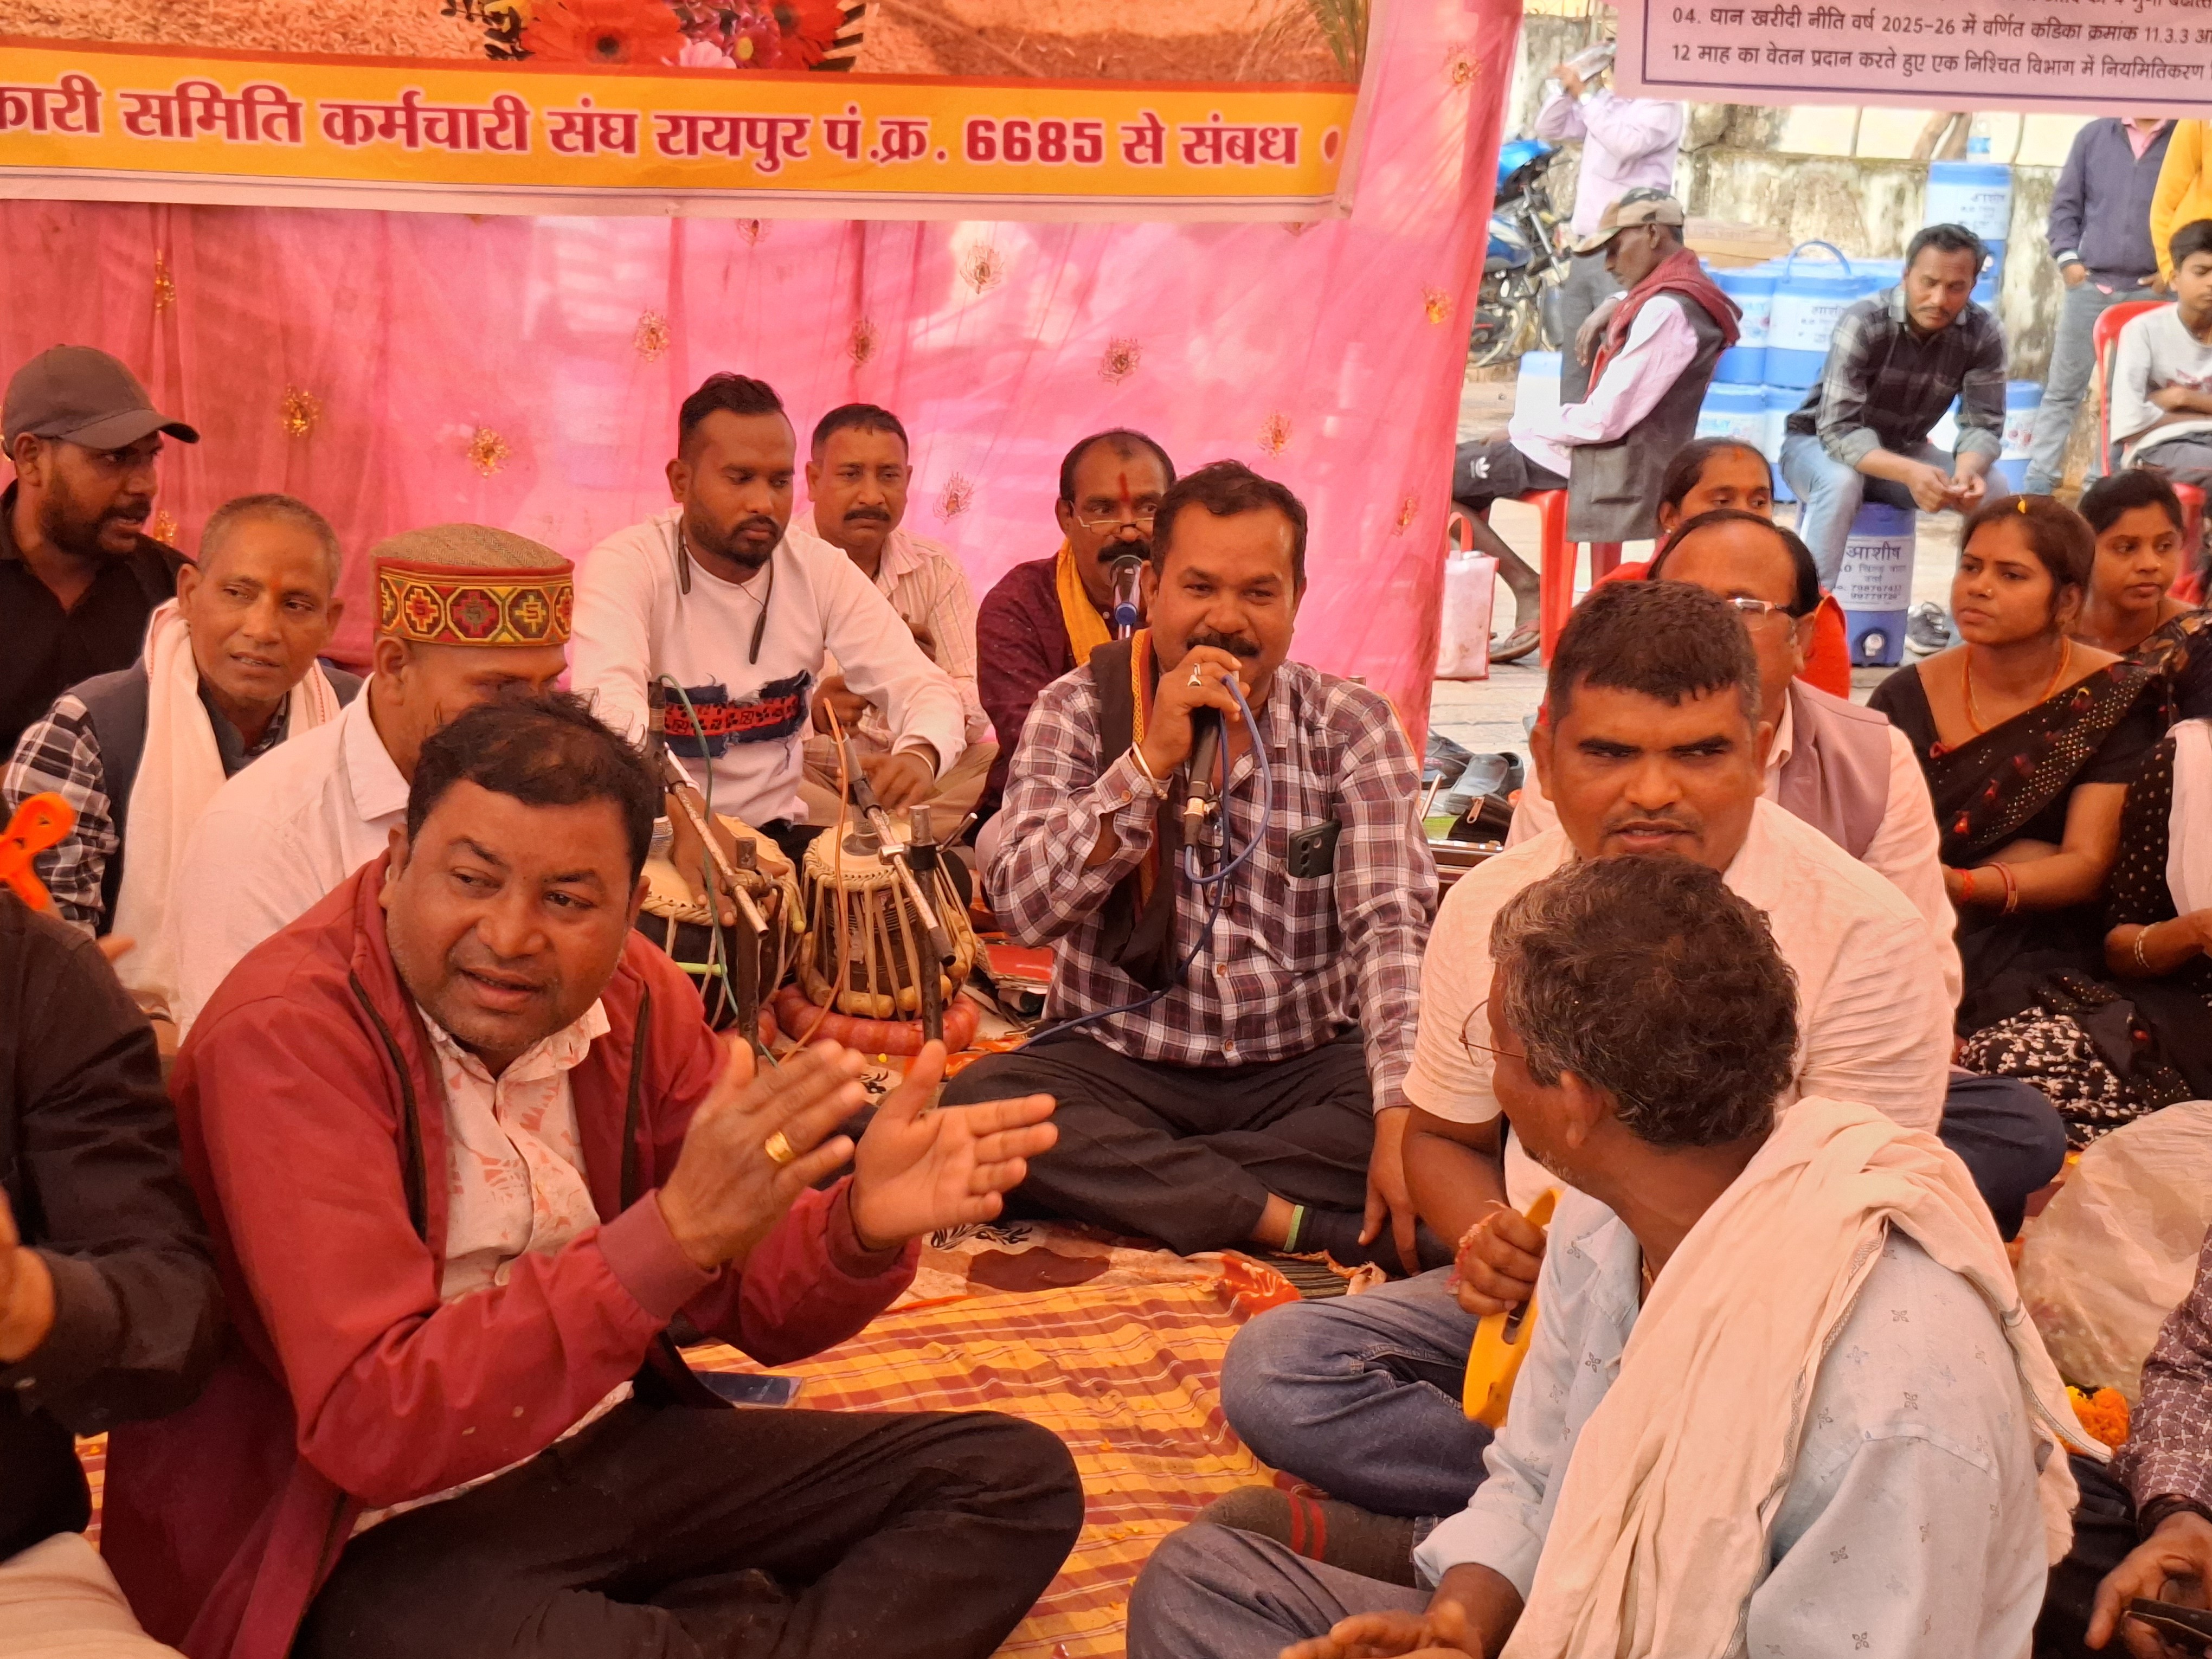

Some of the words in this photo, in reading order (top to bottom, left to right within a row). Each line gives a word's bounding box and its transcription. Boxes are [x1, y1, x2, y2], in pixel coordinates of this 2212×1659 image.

[1673, 7, 1701, 24] 04.
[1710, 9, 1745, 25] धान
[1751, 4, 1802, 28] खरीदी
[1808, 6, 1846, 29] नीति
[1851, 8, 1876, 30] वर्ष
[1882, 16, 1955, 34] 2025-26
[1962, 13, 1977, 35] में
[1983, 14, 2025, 36] वर्णित
[2088, 21, 2139, 41] क्रमांक
[2145, 27, 2189, 44] 11.3.3
[1673, 45, 1690, 61] 12
[1697, 46, 1732, 64] माह
[1738, 48, 1760, 63] का
[1766, 41, 1805, 65] वेतन
[1811, 50, 1853, 67] प्रदान
[1859, 47, 1897, 68] करते
[1903, 54, 1925, 76] हुए
[1932, 55, 1959, 72] एक
[2028, 52, 2075, 75] विभाग
[2081, 54, 2095, 76] में
[2101, 55, 2204, 80] नियमितिकरण
[119, 82, 303, 144] समिति
[321, 91, 531, 152] कर्मचारी
[548, 98, 639, 155] संघ
[655, 114, 810, 172] रायपुर
[967, 120, 1102, 163] 6685
[1122, 112, 1164, 164] से
[1181, 113, 1297, 164] संबध
